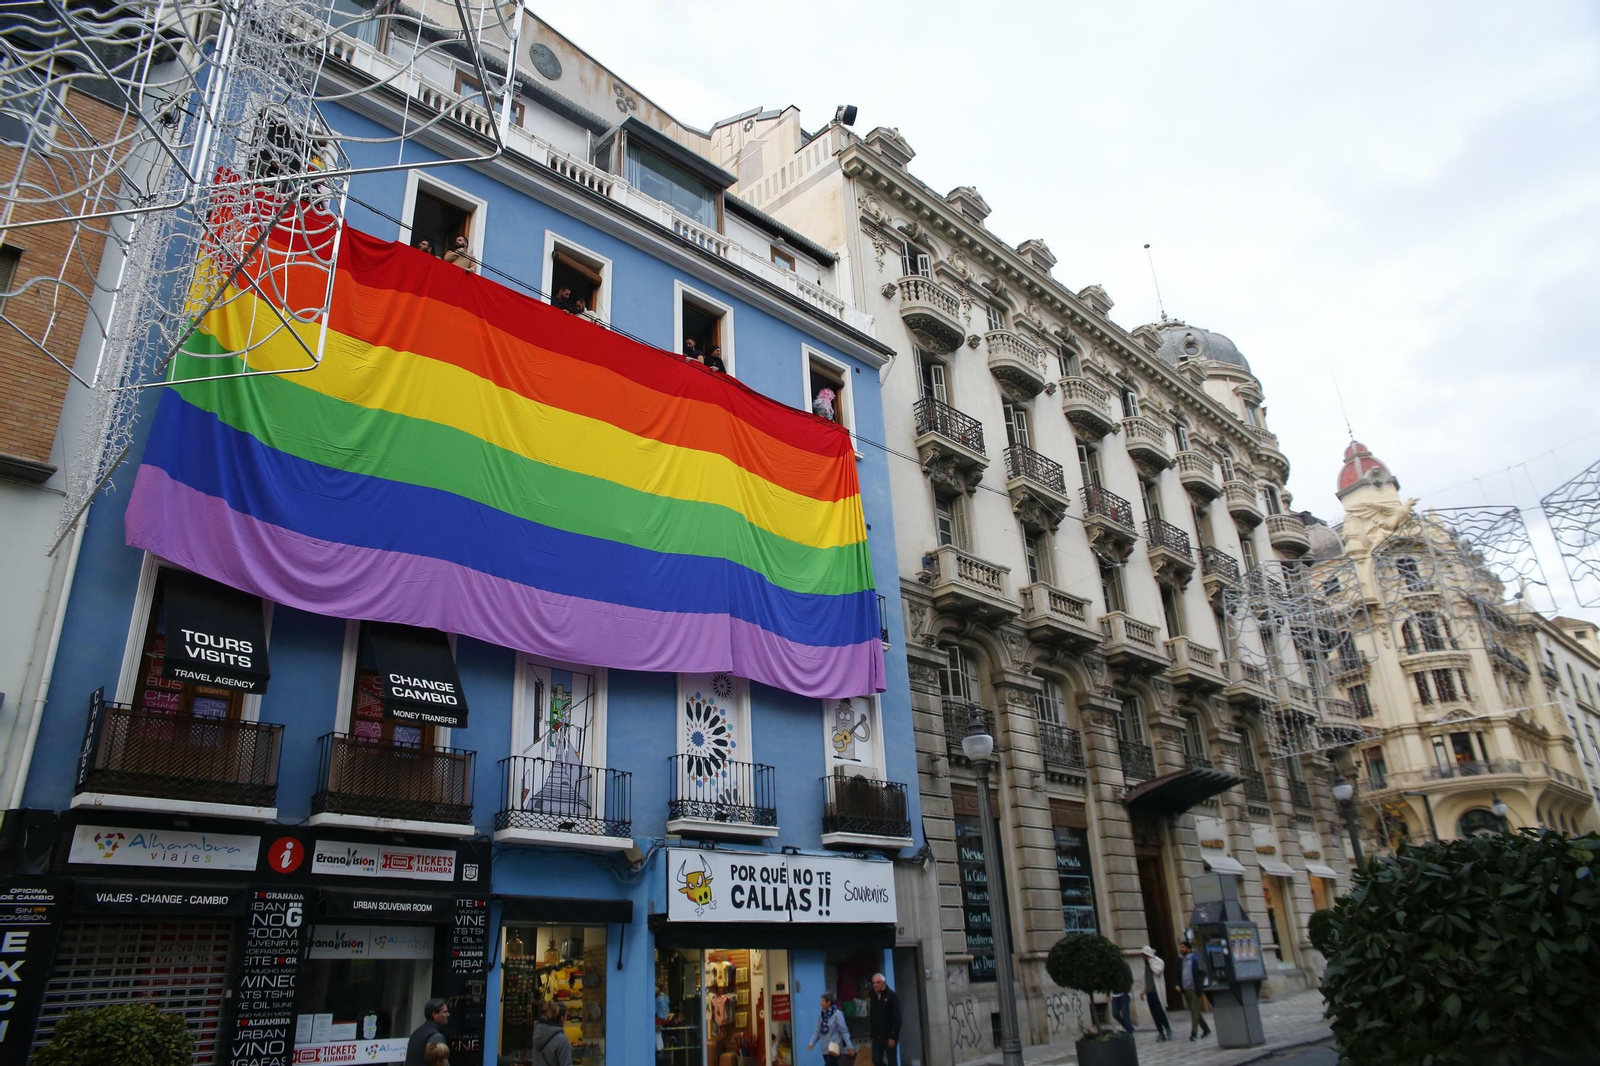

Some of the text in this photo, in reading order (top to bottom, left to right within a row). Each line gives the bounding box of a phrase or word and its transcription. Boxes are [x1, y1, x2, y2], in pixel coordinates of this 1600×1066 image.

[181, 628, 253, 654] TOURS
[184, 645, 252, 668] VISITS
[146, 676, 182, 689] BUS
[174, 668, 255, 689] TRAVEL AGENCY
[389, 673, 455, 693] CHANGE
[391, 686, 458, 705] CAMBIO
[393, 709, 458, 725] MONEY TRANSFER
[79, 689, 100, 784] CHANGE
[128, 833, 241, 854] Alhambra
[151, 850, 212, 865] viajes
[417, 855, 453, 868] TICKETS
[416, 866, 452, 877] ALHAMBRA
[731, 861, 832, 887] POR QUÉ NO TE
[21, 894, 55, 902] CAMBIO
[265, 892, 304, 900] GRANADA
[844, 880, 889, 904] Souvenirs
[96, 893, 133, 903] VIAJES
[140, 893, 183, 905] CHANGE
[190, 895, 229, 906] CAMBIO
[353, 900, 432, 912] URBAN SOUVENIR ROOM
[15, 907, 33, 915] SIN
[461, 936, 475, 944] OIL
[253, 1001, 271, 1010] OIL
[247, 1017, 291, 1027] ALHAMBRA
[323, 1045, 357, 1056] TICKETS
[323, 1054, 356, 1064] ALHAMBRA
